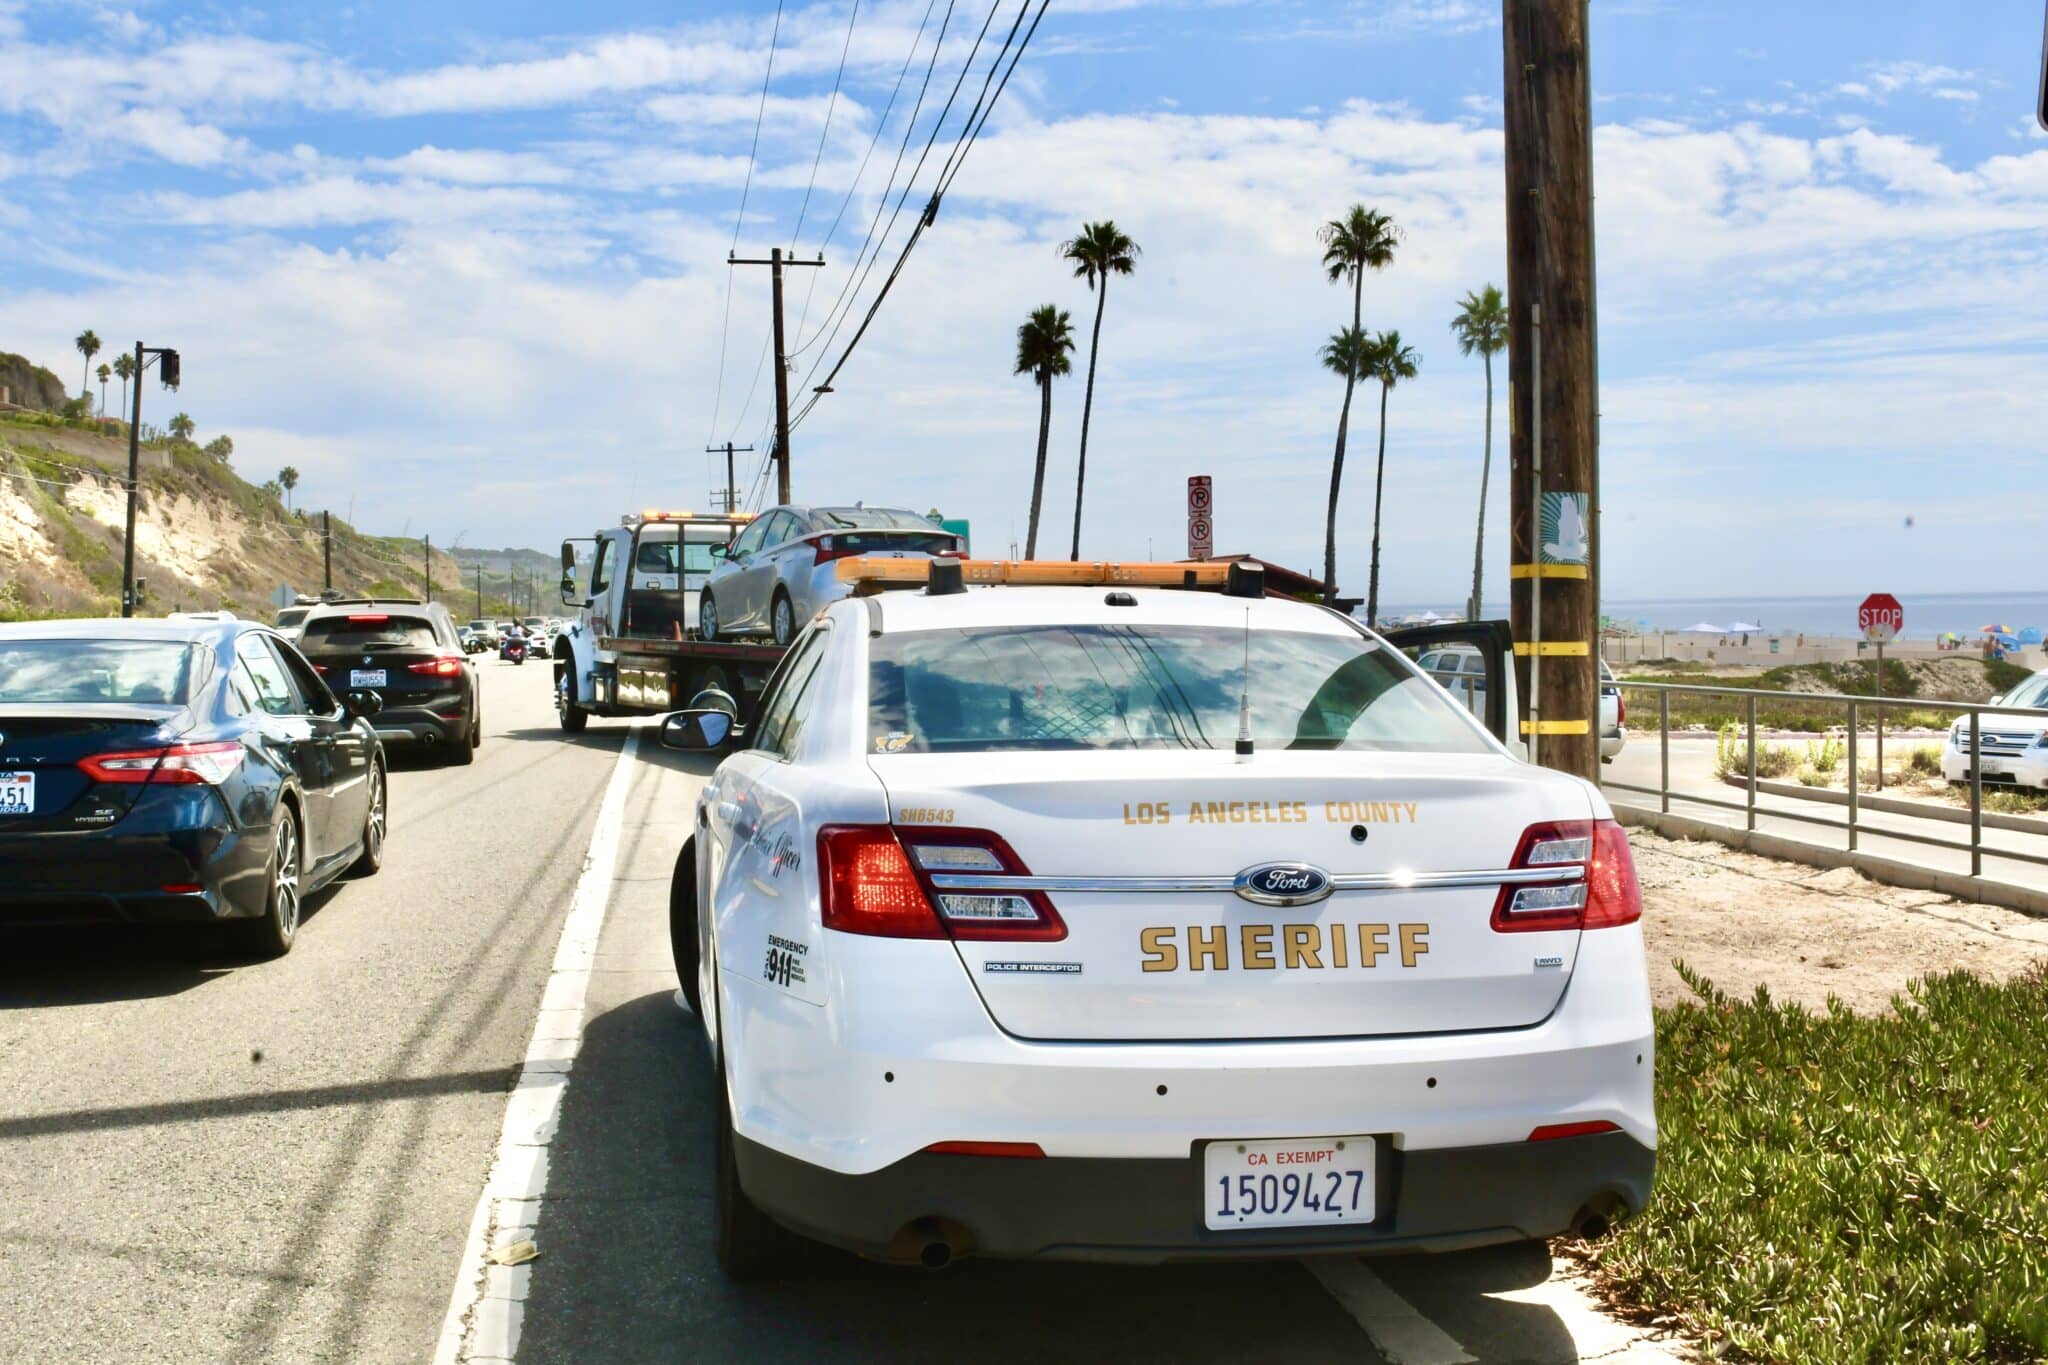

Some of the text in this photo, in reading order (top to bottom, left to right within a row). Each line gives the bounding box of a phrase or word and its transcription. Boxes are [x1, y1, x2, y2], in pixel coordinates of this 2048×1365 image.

[1860, 608, 1902, 625] STOP
[899, 807, 955, 823] SH6543
[1123, 801, 1417, 825] LOS ANGELES COUNTY
[1265, 869, 1310, 890] Ford
[768, 934, 809, 956] EMERGENCY
[1140, 922, 1430, 972] SHERIFF
[986, 963, 1080, 972] POLICE INTERCEPTOR
[1248, 1150, 1335, 1166] CA EXEMPT
[1217, 1170, 1365, 1216] 1509427
